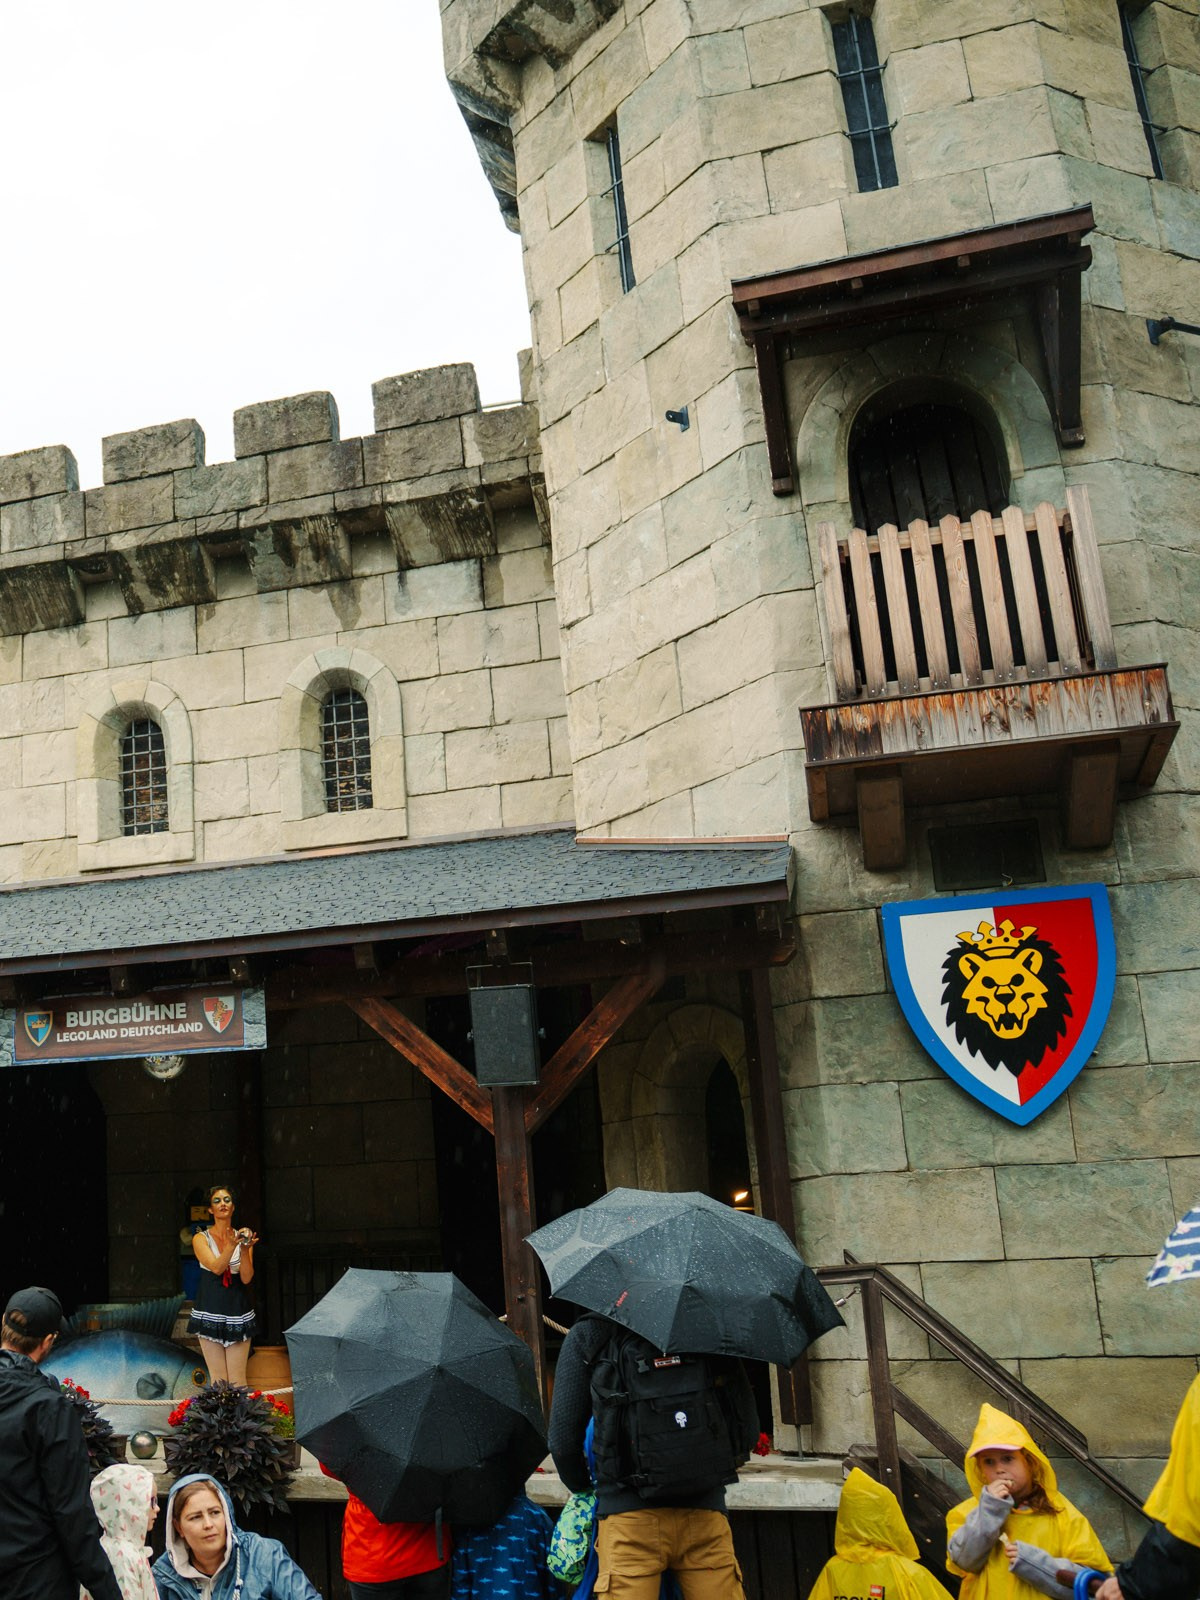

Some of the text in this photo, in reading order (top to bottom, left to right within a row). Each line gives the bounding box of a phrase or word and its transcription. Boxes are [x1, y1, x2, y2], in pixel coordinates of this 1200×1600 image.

[66, 1002, 187, 1028] BURGBÜHNE
[56, 1021, 204, 1043] LEGOLAND DEUTSCHLAND
